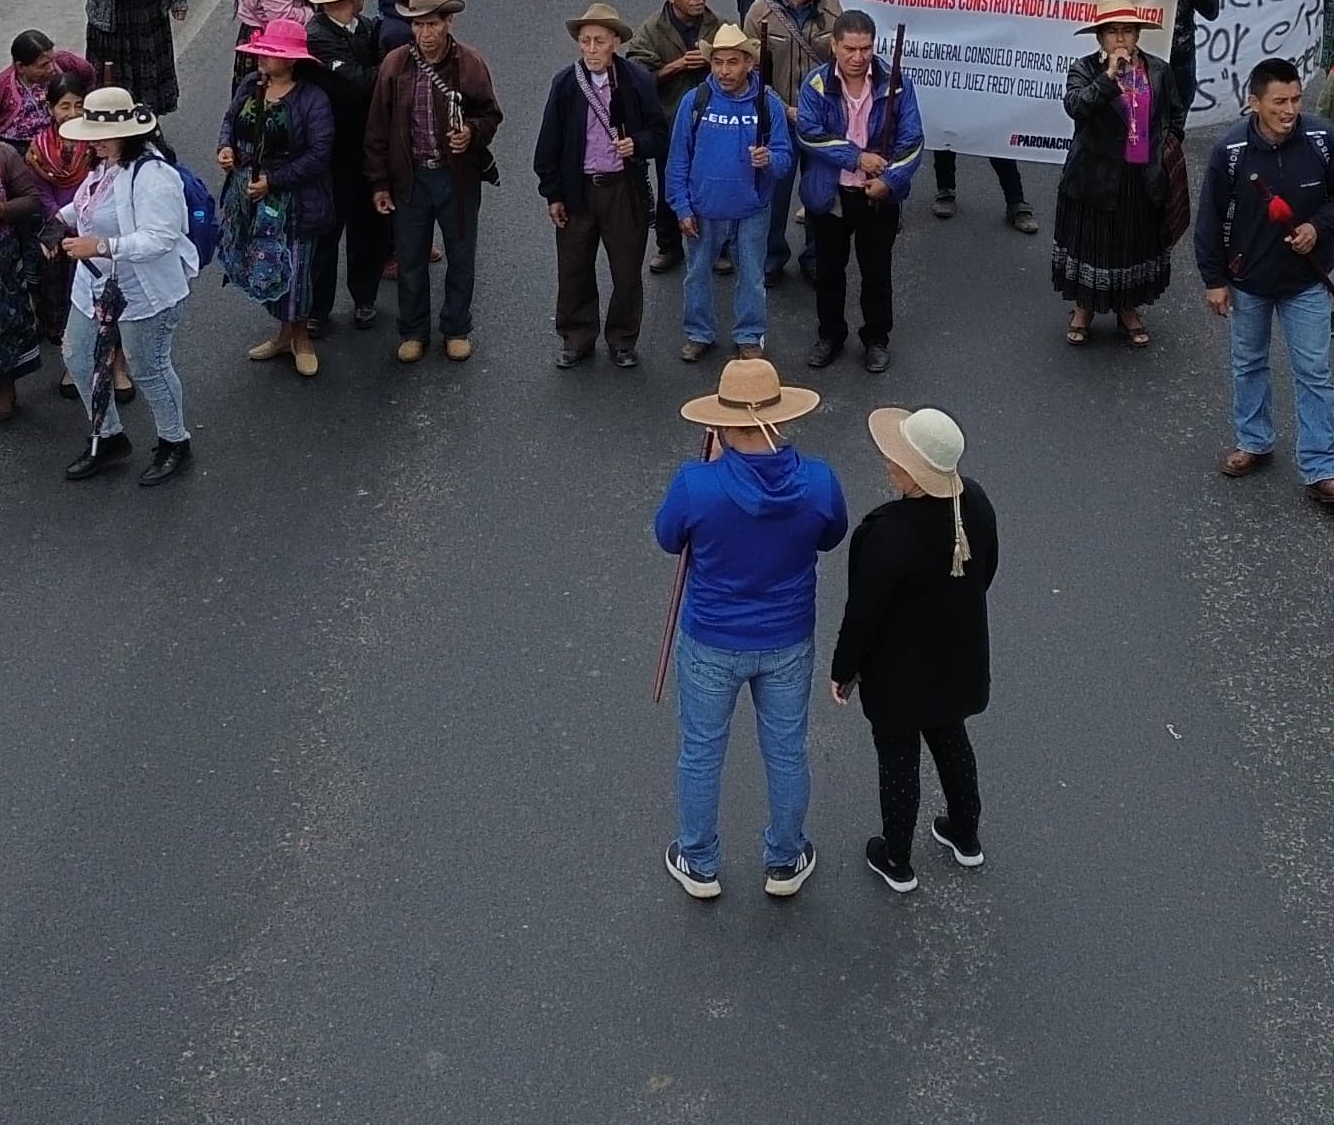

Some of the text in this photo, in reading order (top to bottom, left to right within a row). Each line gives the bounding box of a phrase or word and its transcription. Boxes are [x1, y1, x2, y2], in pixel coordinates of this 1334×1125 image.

[1046, 0, 1061, 20] LA
[1061, 1, 1099, 24] NUEVA
[876, 36, 888, 55] LA
[890, 38, 919, 59] FCAL
[922, 43, 962, 63] GENERAL
[964, 46, 1012, 69] CONSUELO
[1014, 49, 1053, 73] PORRAS,
[943, 70, 951, 88] Y
[952, 72, 962, 89] EL
[963, 74, 985, 93] JUEZ
[987, 75, 1015, 96] FREDY
